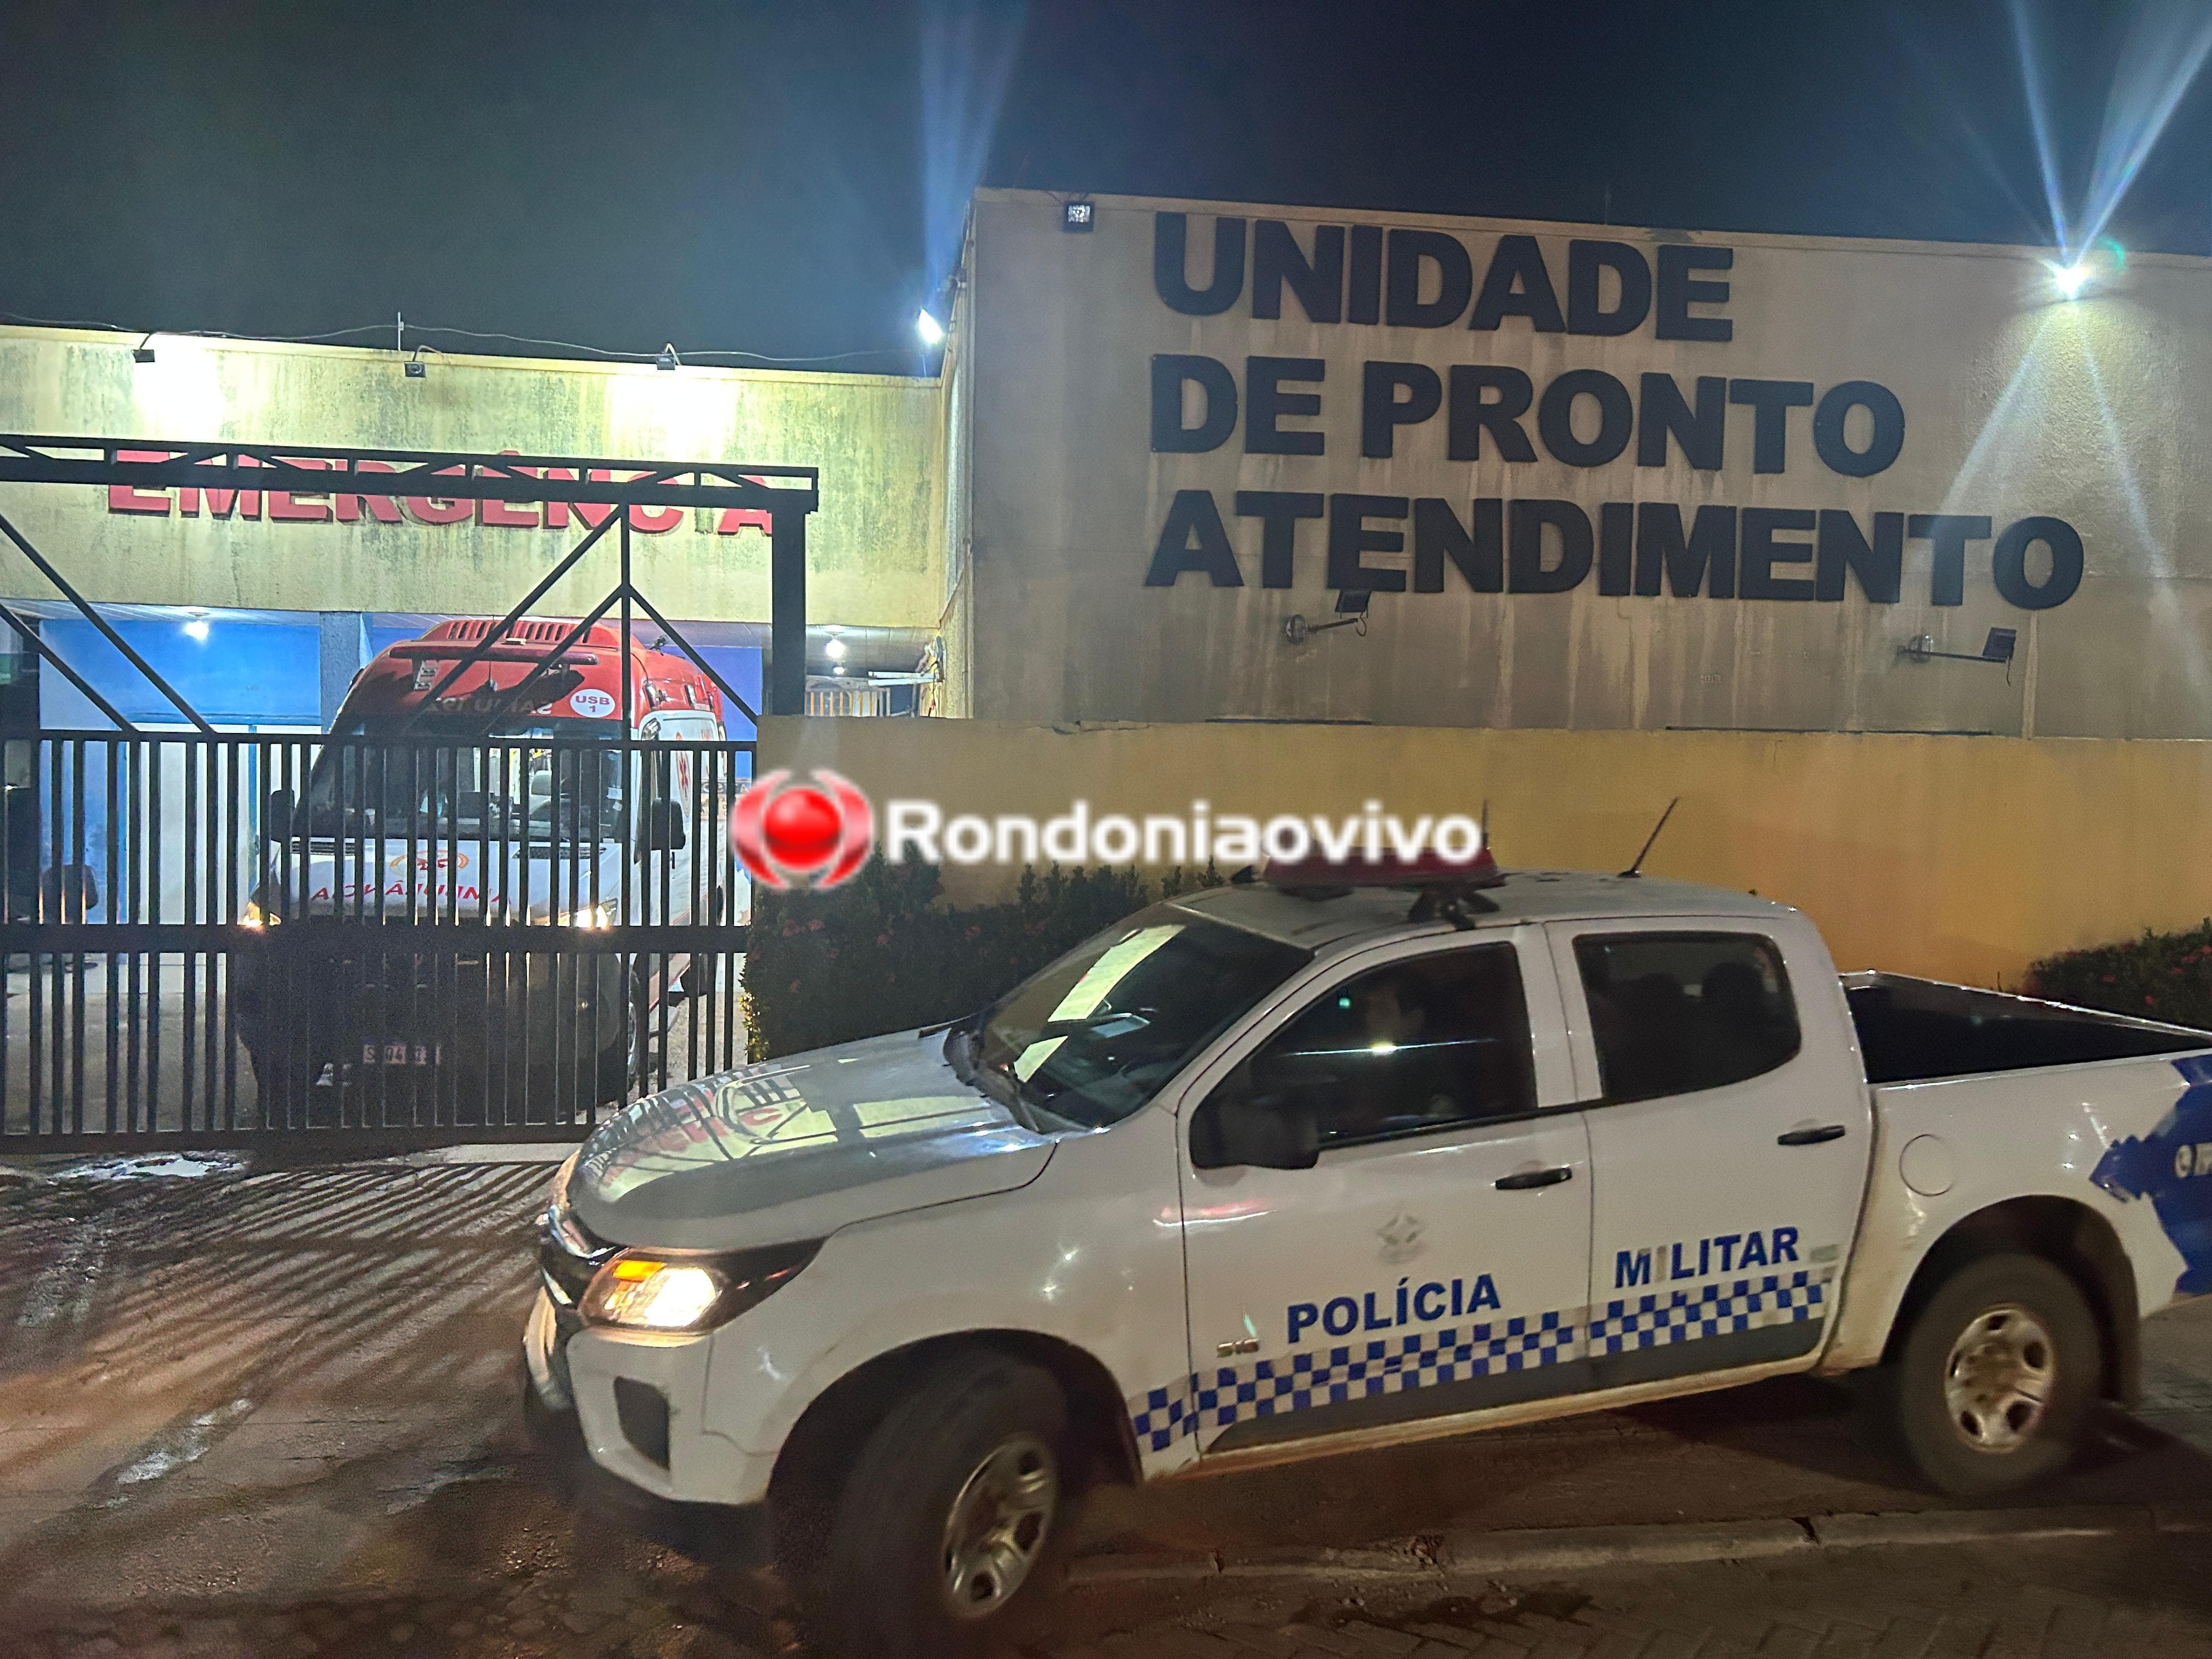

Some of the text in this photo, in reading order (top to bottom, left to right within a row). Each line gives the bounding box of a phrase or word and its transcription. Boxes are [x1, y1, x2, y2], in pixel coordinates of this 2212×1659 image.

[1154, 211, 1734, 342] UNIDADE
[1151, 353, 1905, 478] DE PRONTO
[1143, 488, 2086, 611] ATENDIMENTO
[575, 695, 610, 705] USB
[1287, 1226, 1799, 1344] POLÍCIA MILITAR
